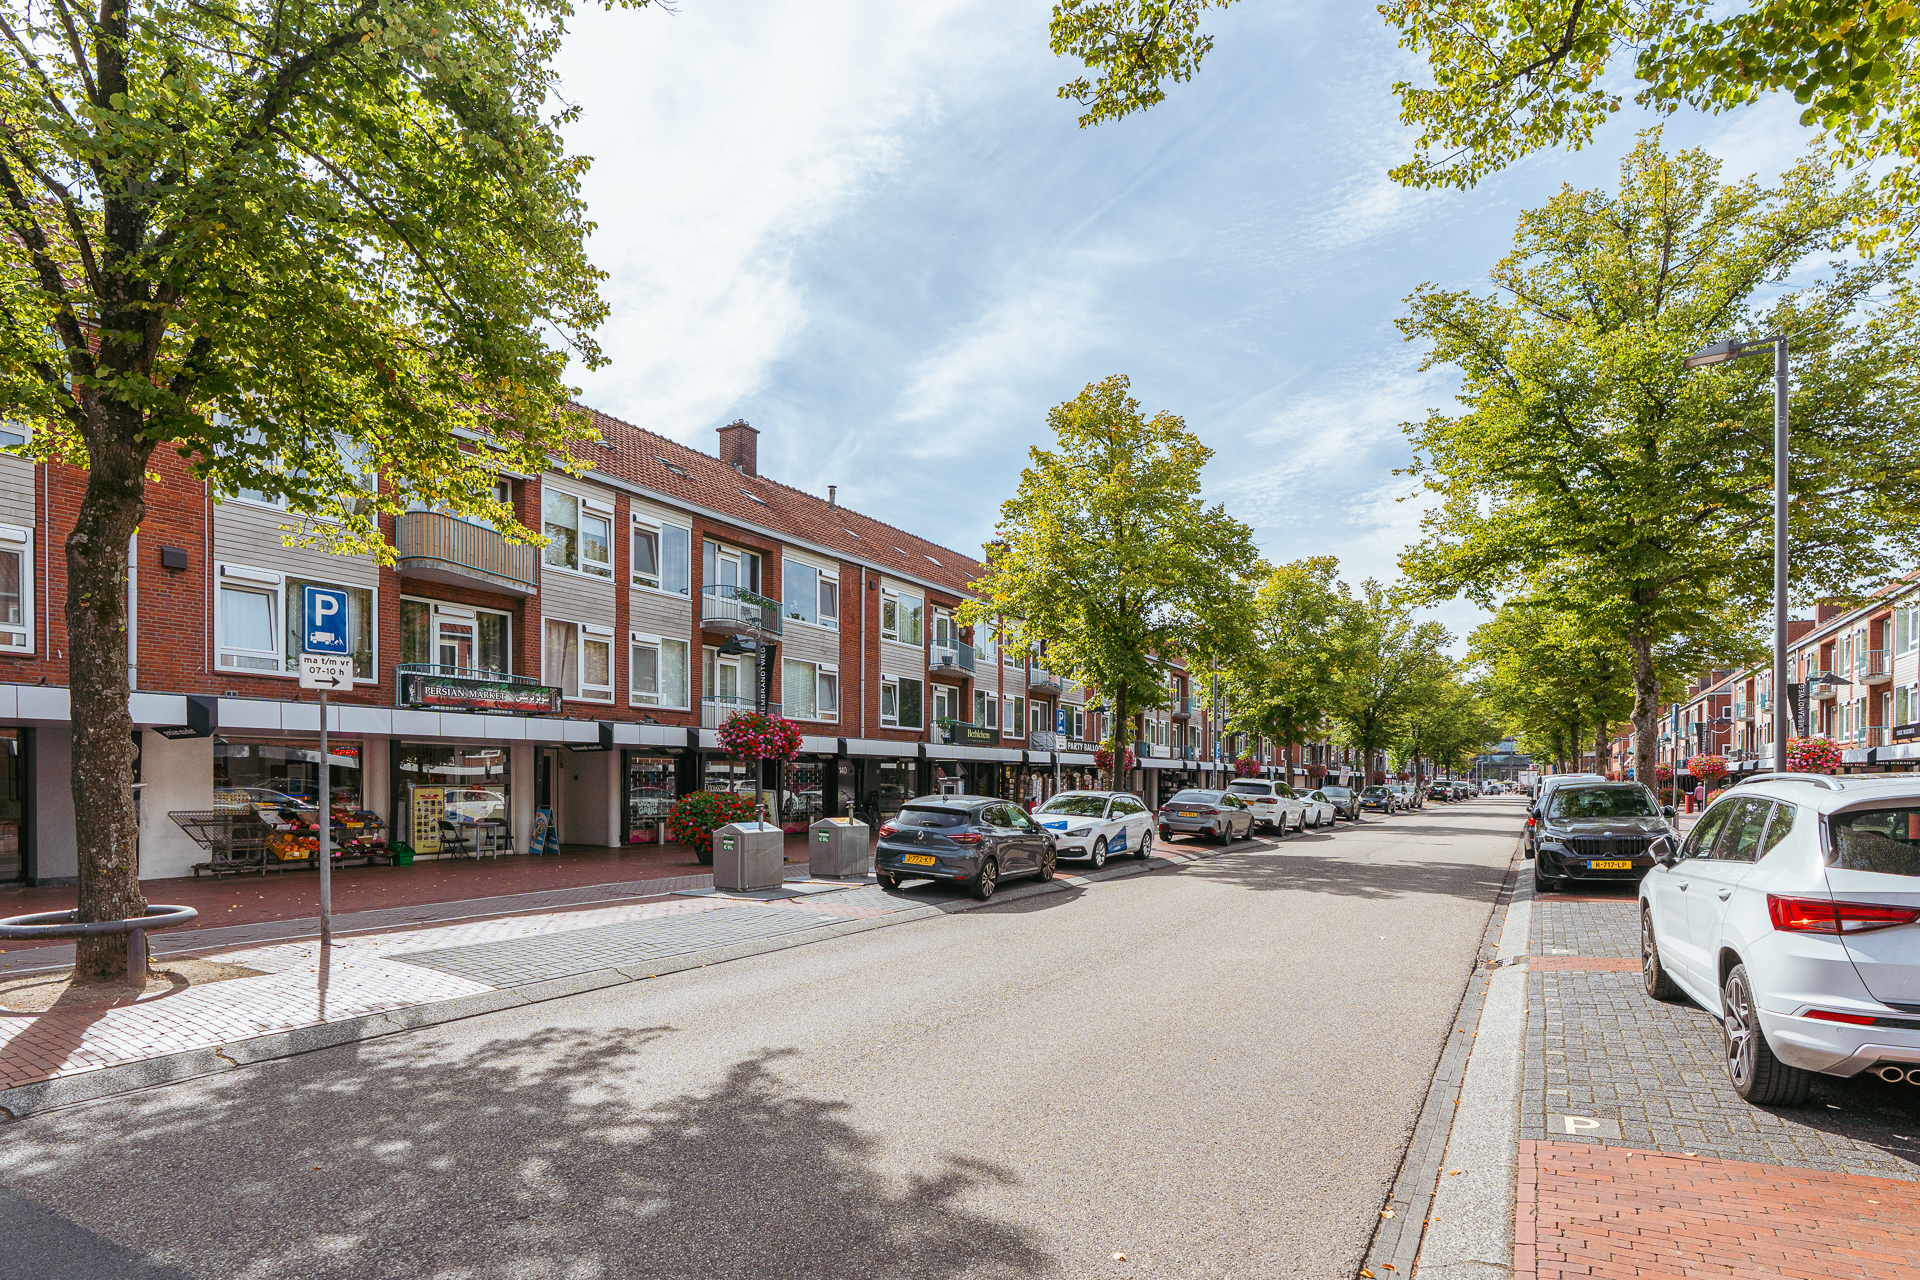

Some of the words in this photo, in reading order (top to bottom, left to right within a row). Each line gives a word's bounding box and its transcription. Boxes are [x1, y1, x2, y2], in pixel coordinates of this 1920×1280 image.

[315, 594, 339, 626] P
[321, 658, 337, 666] t/m
[309, 666, 336, 675] 07-10
[339, 668, 344, 676] h
[425, 686, 465, 697] PERSIAN
[468, 690, 506, 700] MARKET
[1058, 712, 1064, 724] P
[967, 728, 991, 739] Bethlehem
[1067, 742, 1083, 751] PARTY
[839, 766, 848, 775] 140
[1564, 1116, 1600, 1134] P
